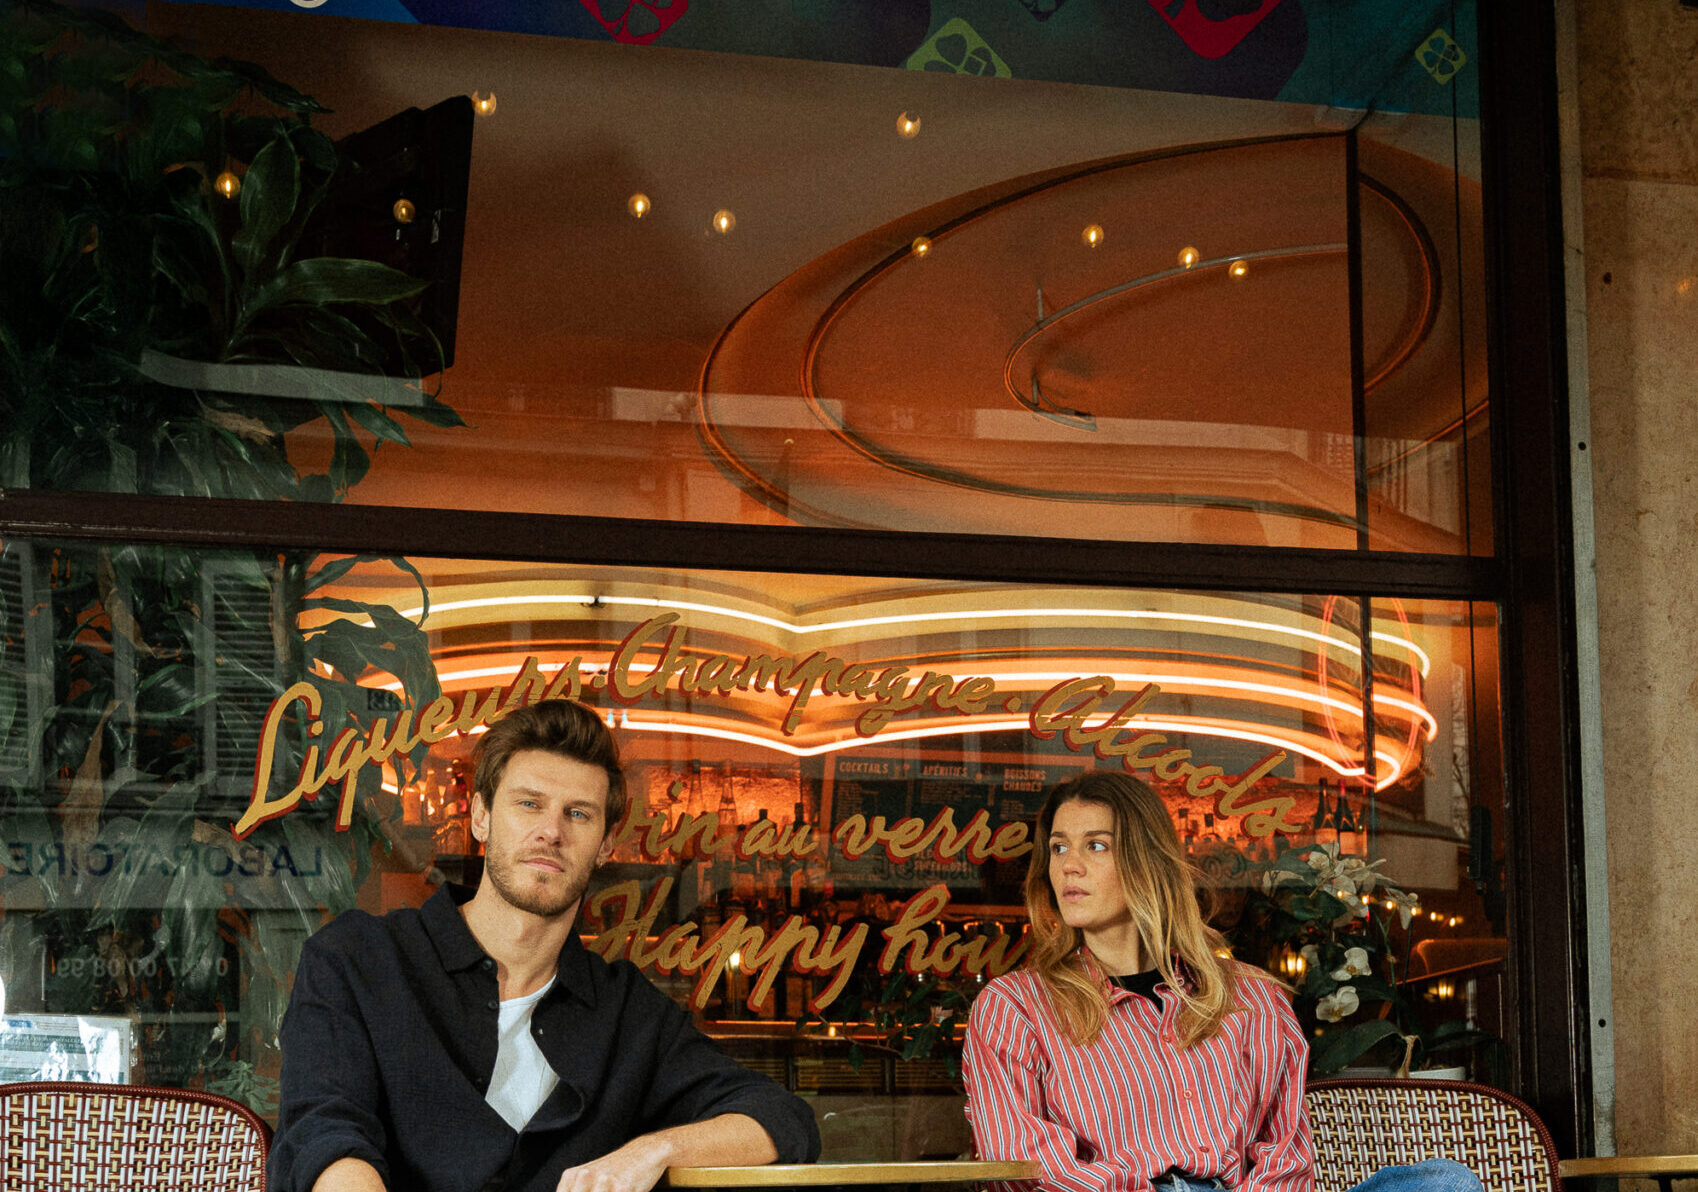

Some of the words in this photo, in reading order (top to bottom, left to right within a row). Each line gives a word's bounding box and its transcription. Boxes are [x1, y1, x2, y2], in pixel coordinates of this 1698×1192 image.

[231, 656, 583, 842] Liqueurs
[608, 612, 997, 738] Champagne
[1029, 675, 1303, 840] Alcools
[839, 761, 889, 774] COCKTAILS
[735, 818, 820, 861] au
[831, 805, 1034, 865] verre
[584, 876, 870, 1015] Happy
[877, 883, 1037, 979] hou
